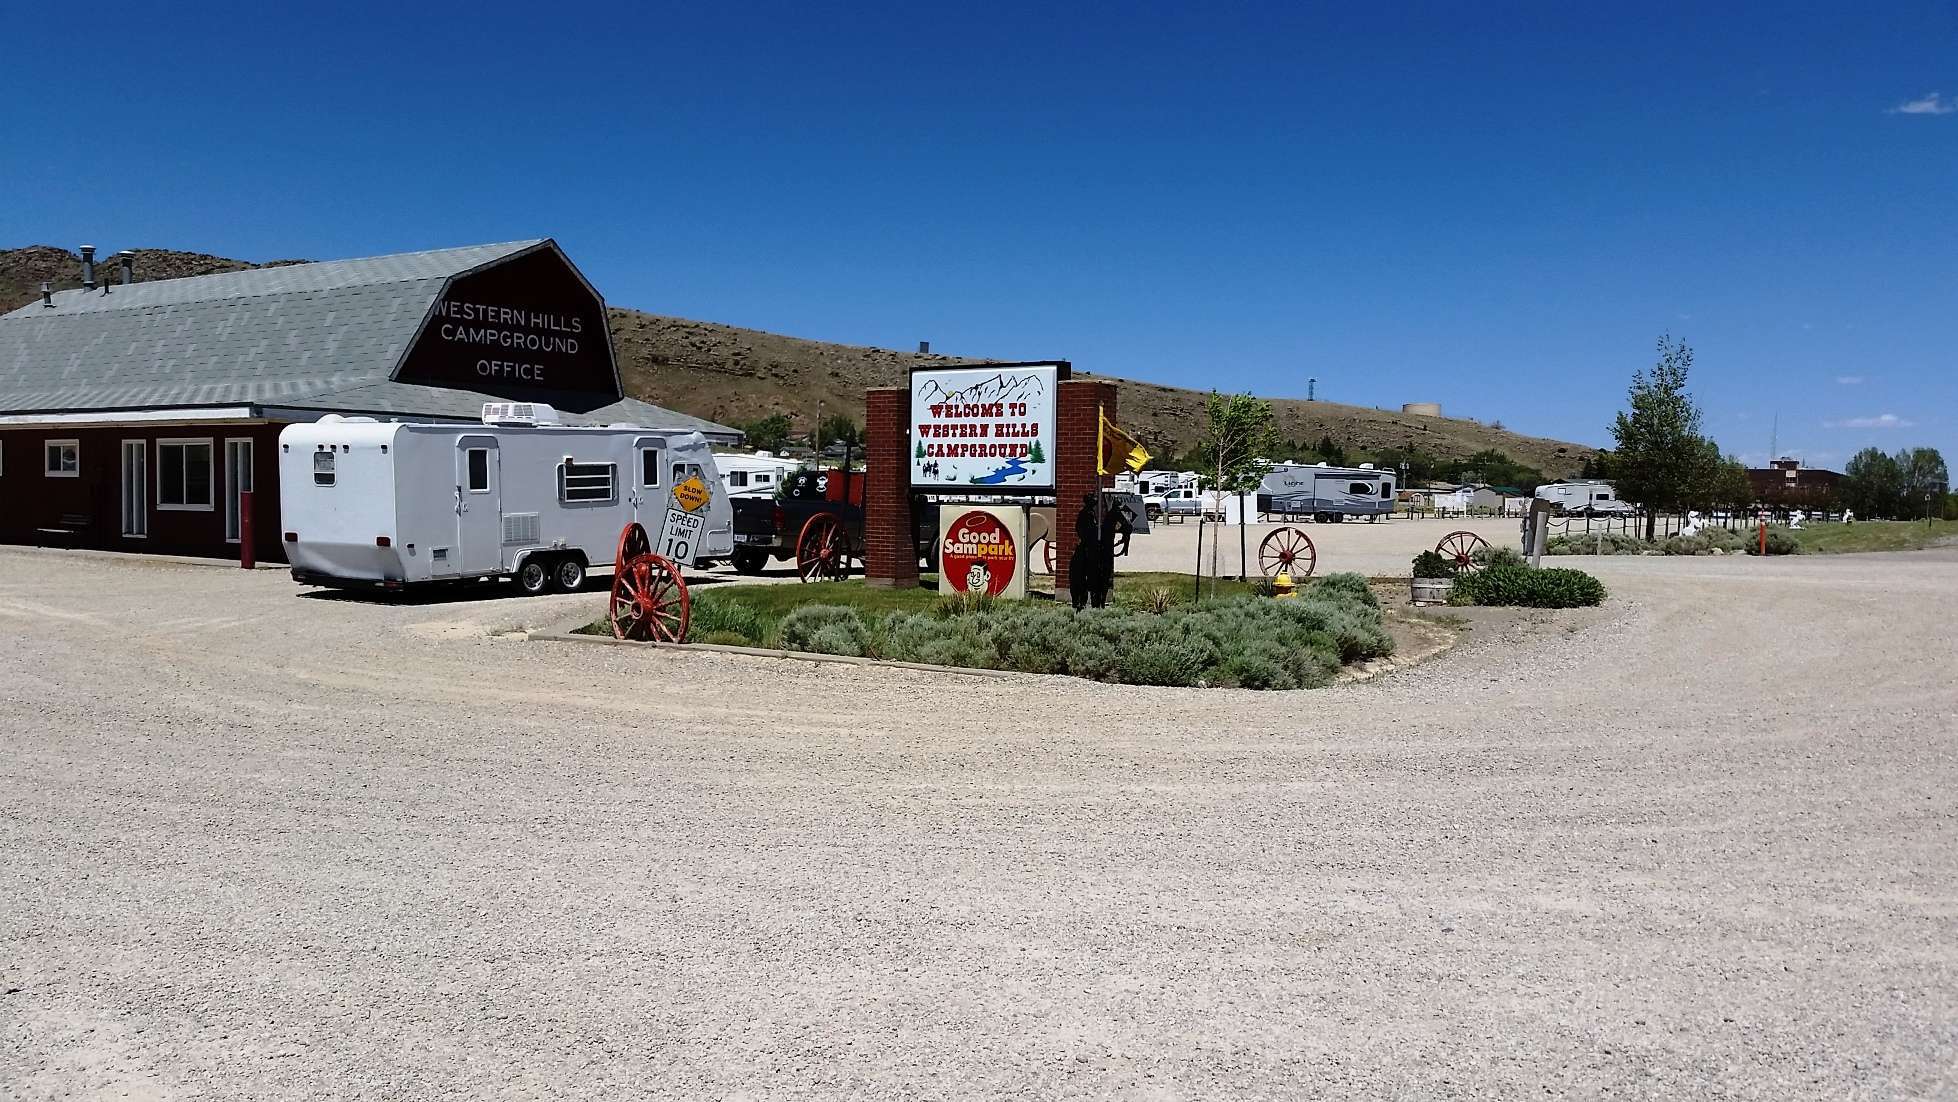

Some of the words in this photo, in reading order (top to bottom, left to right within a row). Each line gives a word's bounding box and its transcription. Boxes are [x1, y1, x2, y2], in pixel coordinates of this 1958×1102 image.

[434, 300, 525, 326] WESTERN
[530, 312, 582, 333] HILLS
[441, 324, 578, 354] CAMPGROUND
[476, 359, 544, 380] OFFICE
[930, 403, 1004, 418] WELCOME
[1009, 402, 1027, 416] TO
[918, 423, 989, 438] WESTERN
[995, 423, 1039, 438] HILLS
[927, 444, 1027, 457] CAMPGROUND
[684, 486, 702, 494] SLOW
[670, 513, 699, 529] SPEED
[670, 526, 693, 539] LIMIT
[958, 528, 1000, 543] Good
[666, 539, 688, 559] 10
